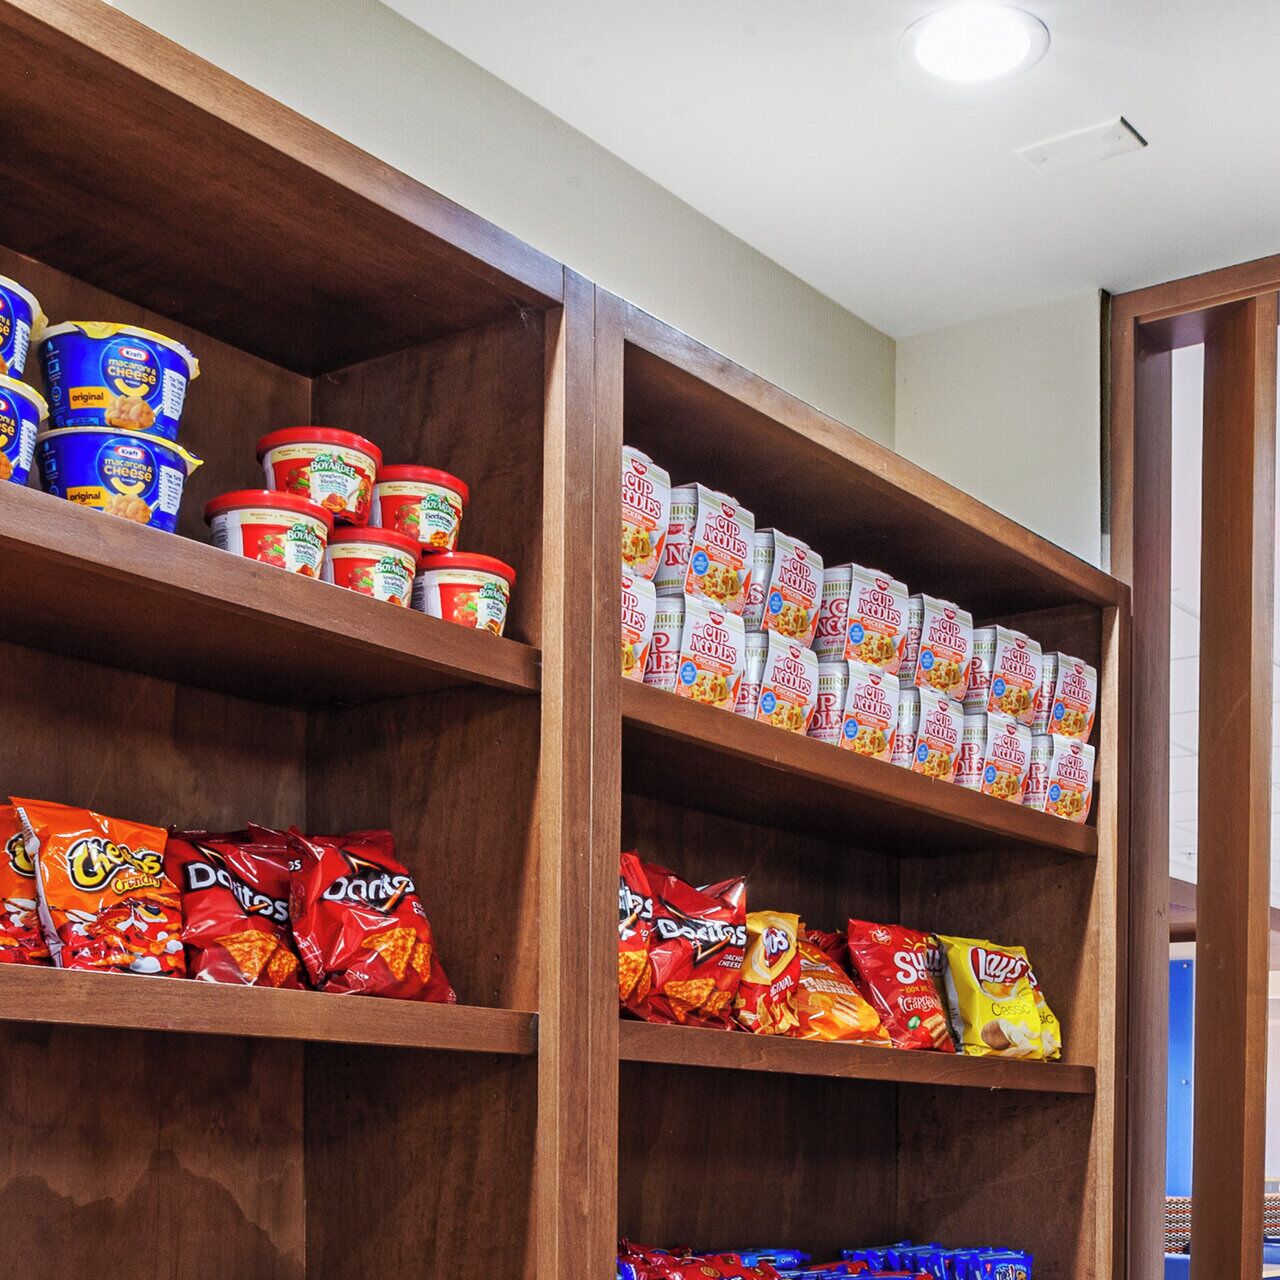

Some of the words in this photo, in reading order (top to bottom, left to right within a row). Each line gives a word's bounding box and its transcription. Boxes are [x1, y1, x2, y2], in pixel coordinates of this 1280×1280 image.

[125, 348, 145, 360] Kraft
[108, 358, 150, 374] macaroni
[71, 391, 104, 404] original
[120, 447, 140, 459] Kraft
[104, 458, 147, 473] macaroni
[625, 471, 654, 495] CUP
[70, 490, 101, 504] original
[715, 515, 741, 538] CUP
[703, 526, 748, 559] NOODLES
[790, 557, 811, 579] CUP
[779, 567, 817, 599] NOODLES
[871, 588, 894, 608] CUP
[857, 599, 902, 626] NOODLES
[702, 623, 730, 644] CUP
[939, 617, 961, 636] CUP
[689, 633, 737, 665] NOODLES
[927, 627, 968, 654] NOODLES
[1010, 646, 1031, 664] CUP
[784, 656, 806, 676] CUP
[999, 655, 1037, 681] NOODLES
[770, 665, 812, 696] NOODLES
[863, 684, 886, 702] CUP
[852, 694, 893, 720] NOODLES
[933, 709, 953, 727] CUP
[1001, 733, 1020, 751] CUP
[187, 862, 290, 923] Doritos
[991, 1002, 1032, 1017] Classic
